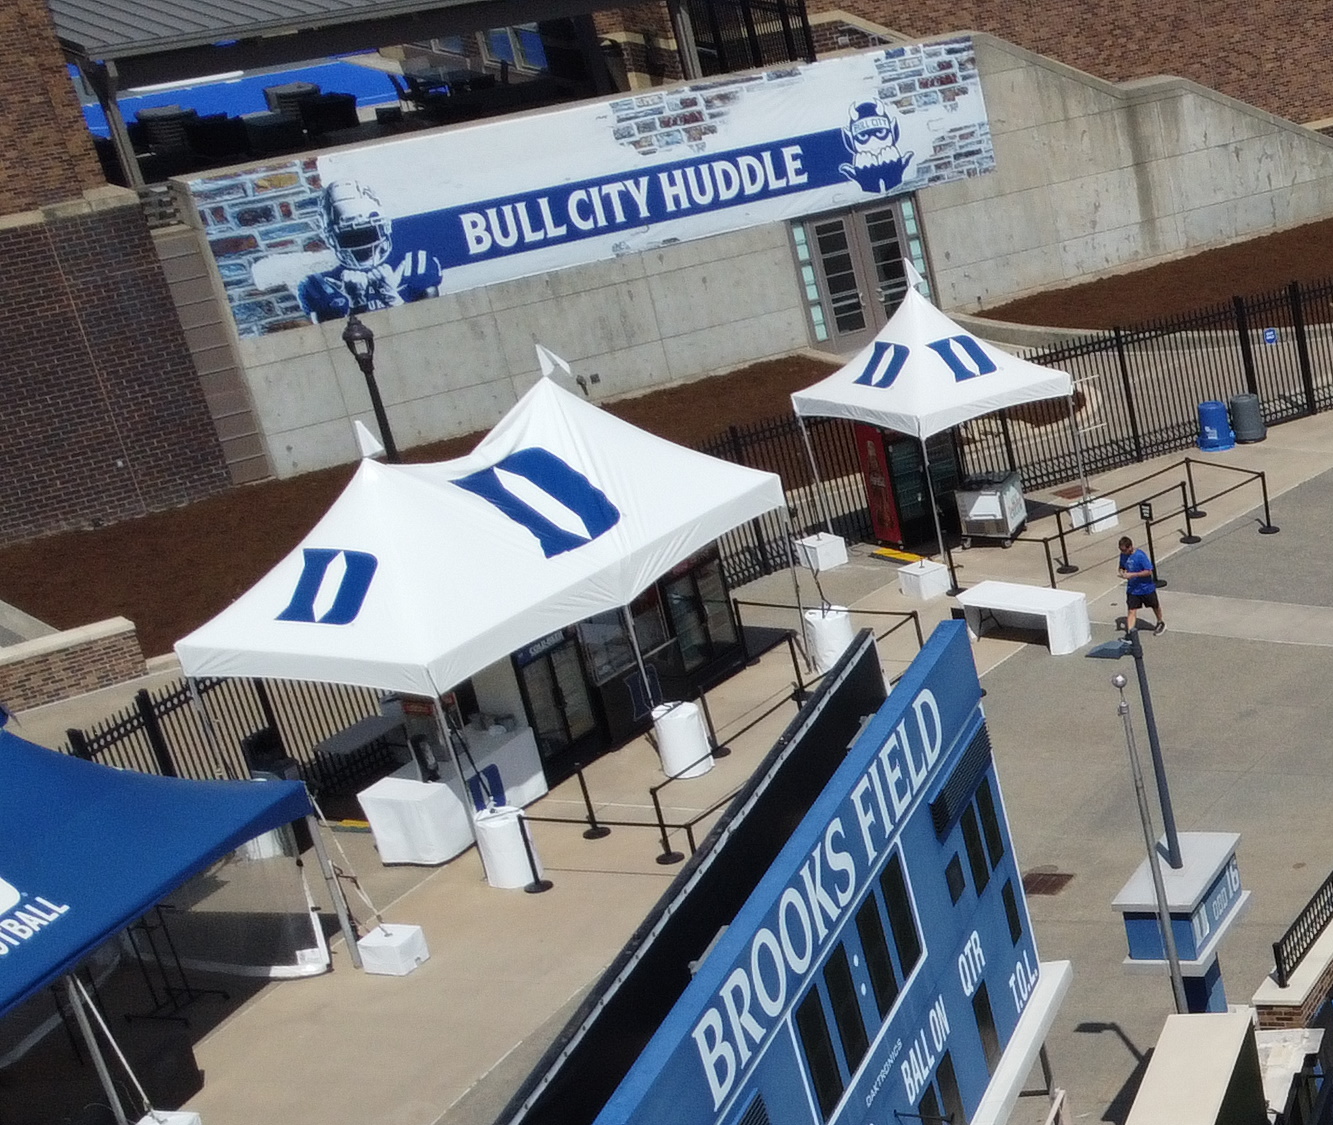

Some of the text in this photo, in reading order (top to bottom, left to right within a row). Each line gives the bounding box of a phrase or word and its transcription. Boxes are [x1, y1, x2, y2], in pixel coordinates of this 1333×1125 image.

[463, 145, 808, 256] BULL CITY HUDDLE
[692, 689, 943, 1112] BROOKS FIELD
[958, 930, 985, 997] QTR
[1009, 958, 1039, 1014] T.O.L.
[865, 1037, 903, 1108] DAKTRONICS
[900, 995, 951, 1106] BALL ON
